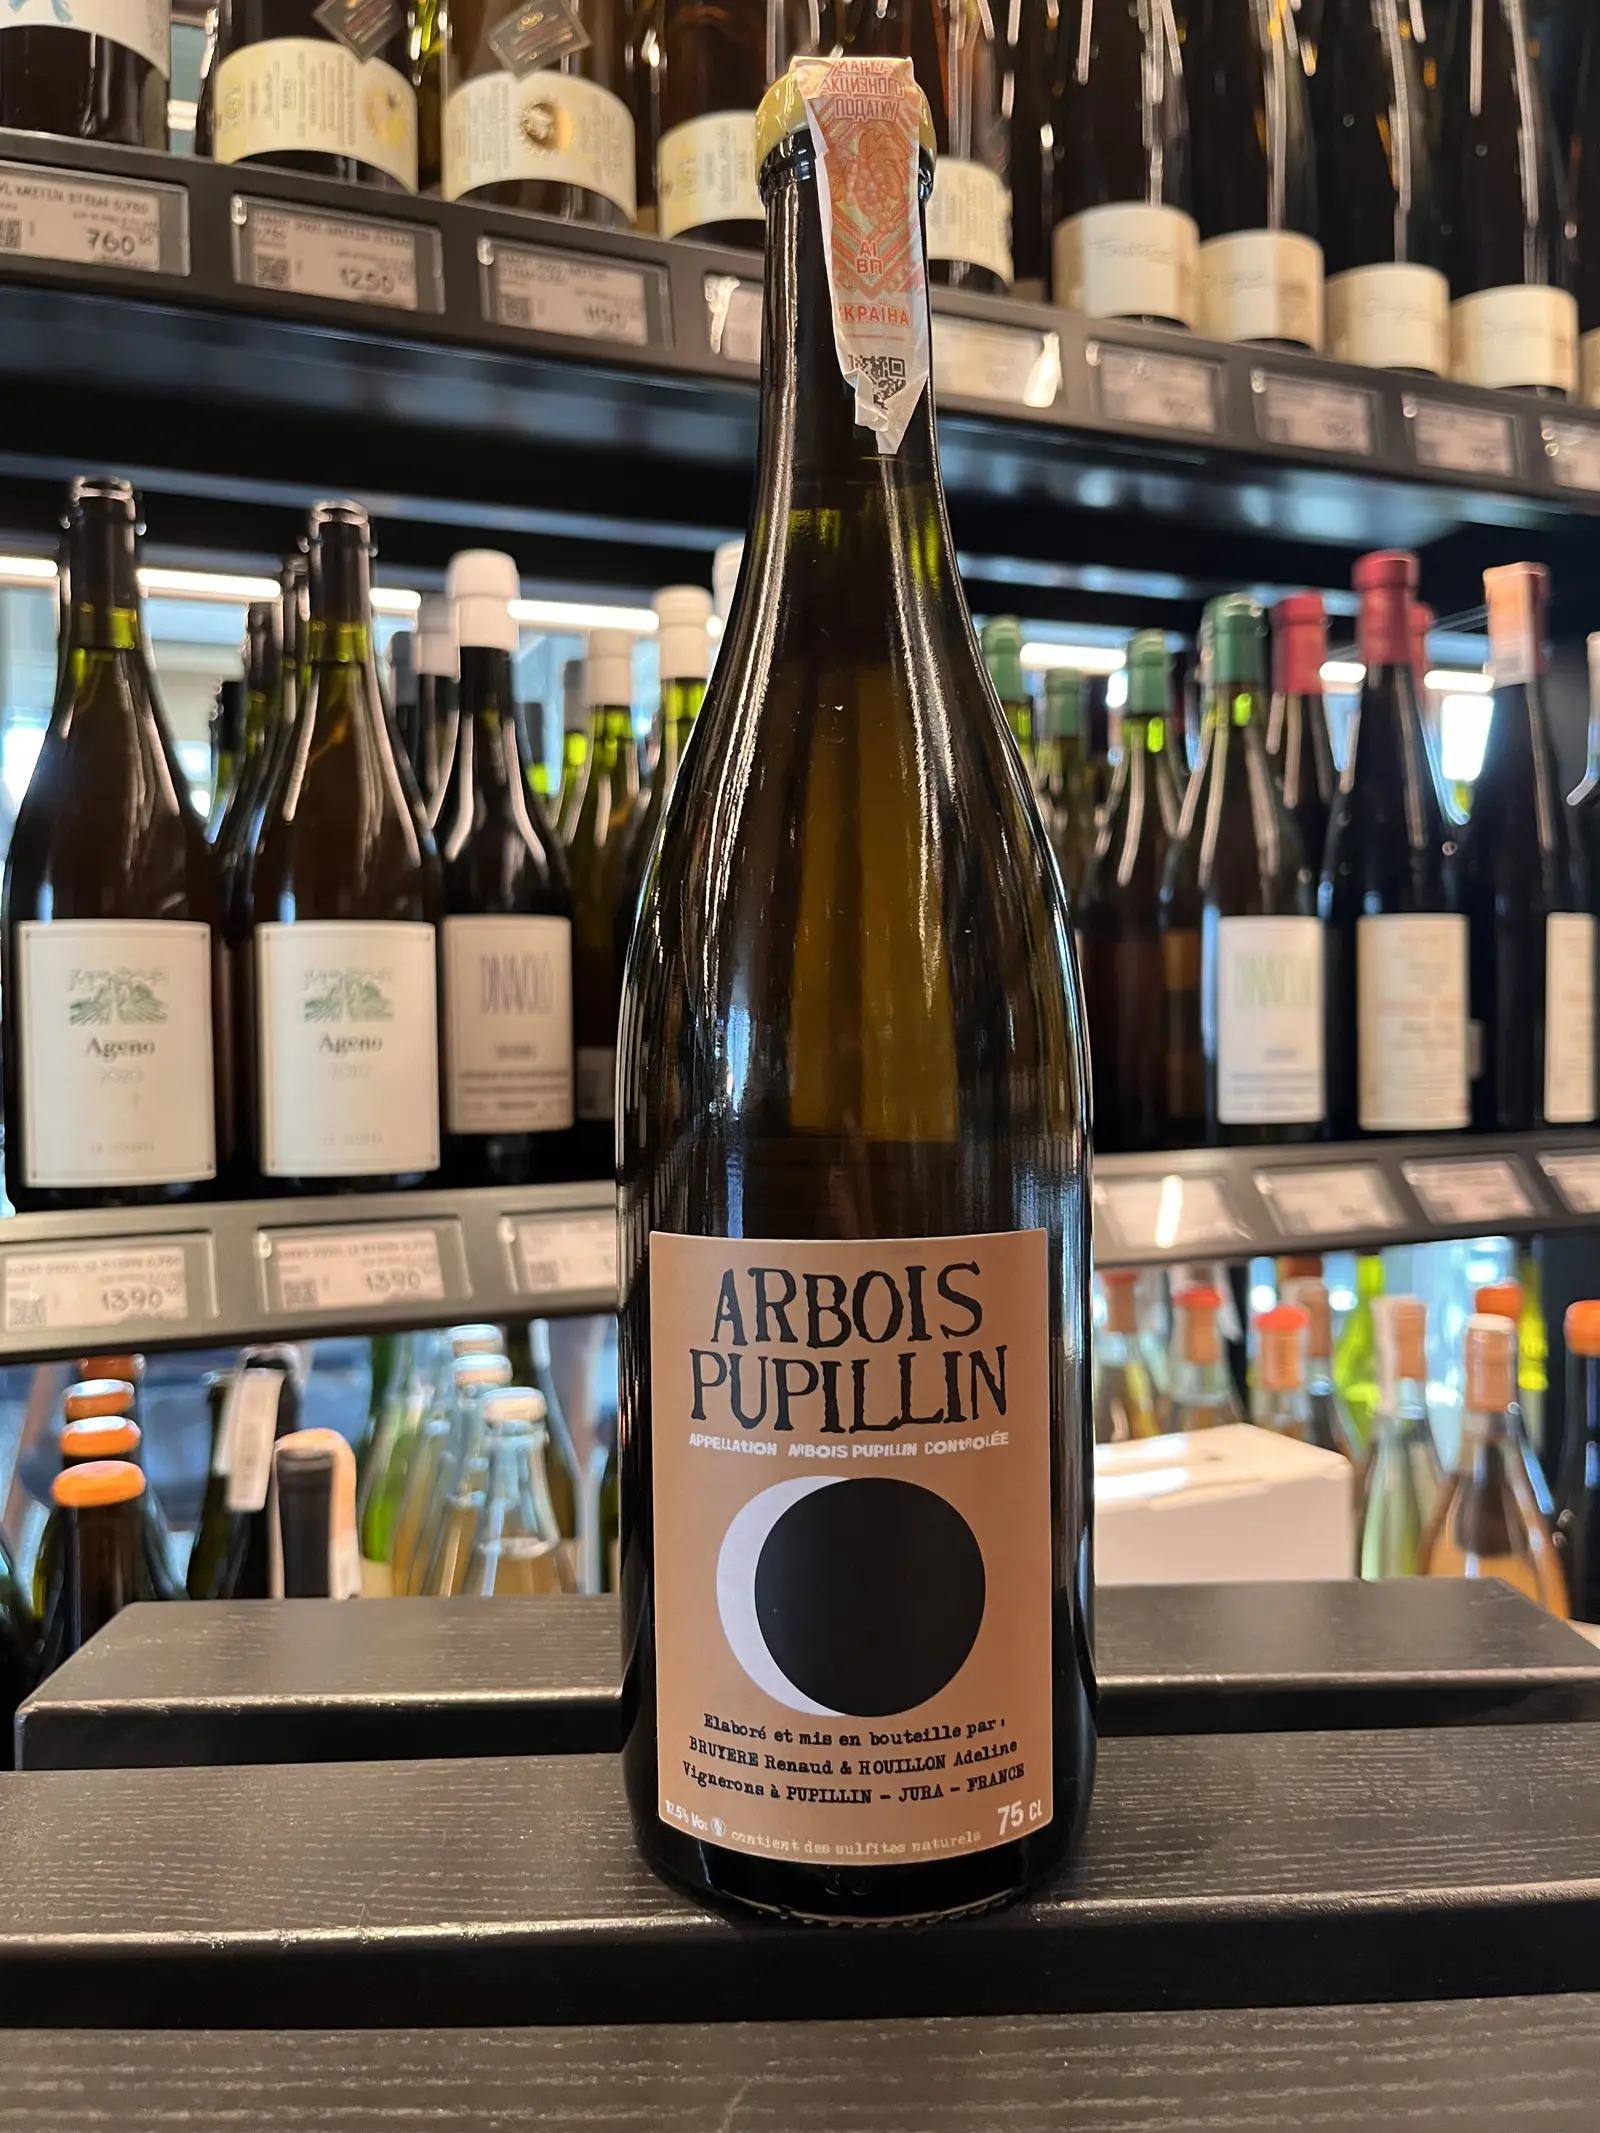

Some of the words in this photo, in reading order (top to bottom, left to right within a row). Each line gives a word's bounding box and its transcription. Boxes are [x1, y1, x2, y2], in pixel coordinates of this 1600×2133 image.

[819, 77, 905, 97] АКЦИЗНОГО
[836, 100, 899, 119] ПОДАТКУ
[87, 227, 136, 256] 760
[857, 259, 883, 274] ВП
[340, 266, 396, 295] 1250
[87, 1036, 156, 1062] Ageno
[319, 1032, 384, 1058] Ageno
[366, 1268, 421, 1293] 1390
[102, 1287, 163, 1313] 1390
[711, 1260, 983, 1349] ARBOIS
[689, 1345, 1008, 1434] PUPILLIN
[788, 1443, 848, 1459] ARBOIS
[852, 1442, 917, 1458] PUPILLIN
[704, 1713, 767, 1740] Elaboré
[774, 1729, 793, 1743] et
[799, 1731, 832, 1745] mis
[839, 1734, 861, 1746] en
[869, 1725, 961, 1745] bouteille
[689, 1735, 759, 1767] BRUYERE
[764, 1754, 833, 1774] Renaud
[840, 1761, 852, 1775] &
[858, 1754, 946, 1775] HOUILLON
[953, 1741, 1017, 1766] Adeline
[683, 1761, 764, 1787] Vignerons
[770, 1783, 780, 1799] à
[786, 1785, 872, 1803] PUPILLIN
[899, 1784, 944, 1802] JURA
[967, 1763, 1024, 1792] FRANCE
[997, 1799, 1024, 1835] 75
[731, 1831, 799, 1851] contient
[804, 1841, 831, 1854] des
[836, 1841, 905, 1855] sulfites
[912, 1831, 981, 1852] naturels
